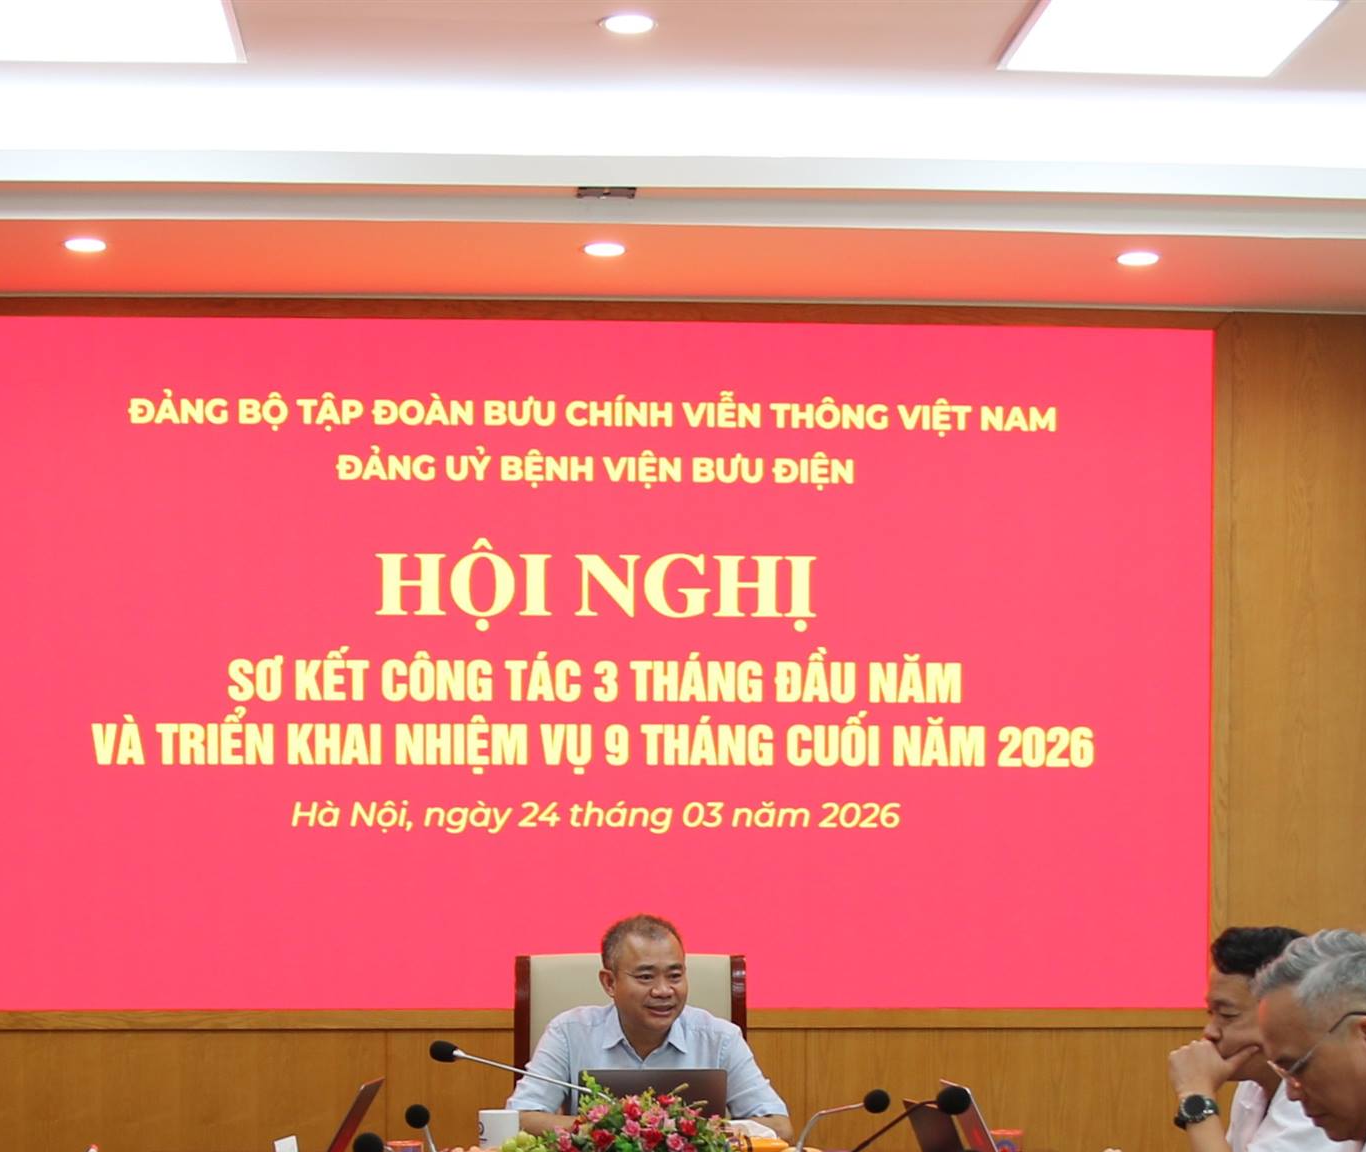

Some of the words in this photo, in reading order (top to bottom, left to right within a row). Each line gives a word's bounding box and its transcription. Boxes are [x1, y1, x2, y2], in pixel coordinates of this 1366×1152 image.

[128, 389, 228, 424] ĐẢNG
[239, 392, 288, 431] BỘ
[296, 392, 363, 431] TẬP
[372, 393, 474, 425] ĐOÀN
[484, 396, 555, 426] BƯU
[566, 395, 673, 427] CHÍNH
[682, 391, 761, 428] VIỄN
[770, 397, 888, 430] THÔNG
[897, 398, 972, 437] VIỆT
[981, 406, 1056, 432] NAM
[336, 445, 435, 481] ĐẢNG
[446, 446, 491, 481] UỶ
[501, 449, 593, 488] BỆNH
[603, 450, 681, 489] VIỆN
[692, 453, 764, 483] BƯU
[772, 452, 854, 491] ĐIỆN
[376, 538, 552, 631] HỘI
[575, 553, 816, 632] NGHỊ
[228, 655, 283, 701] SƠ
[295, 646, 370, 701] KẾT
[382, 651, 493, 702] CÔNG
[505, 651, 581, 702] TÁC
[594, 661, 618, 702] 3
[630, 652, 763, 703] THÁNG
[774, 647, 856, 703] ĐẦU
[869, 654, 962, 703] NĂM
[92, 714, 145, 765] VÀ
[156, 706, 274, 765] TRIỂN
[287, 723, 382, 765] KHAI
[395, 715, 528, 774] NHIỆM
[540, 724, 592, 775] VỤ
[605, 724, 629, 766] 9
[640, 715, 774, 766] THÁNG
[787, 710, 880, 767] CUỐI
[893, 717, 985, 767] NĂM
[998, 726, 1094, 768] 2026
[292, 800, 340, 827] Hà
[351, 800, 413, 833] Nội,
[424, 801, 512, 833] ngày
[518, 802, 560, 827] 24
[570, 801, 673, 834] tháng
[683, 802, 724, 827] 03
[732, 801, 810, 827] năm
[819, 802, 900, 828] 2026
